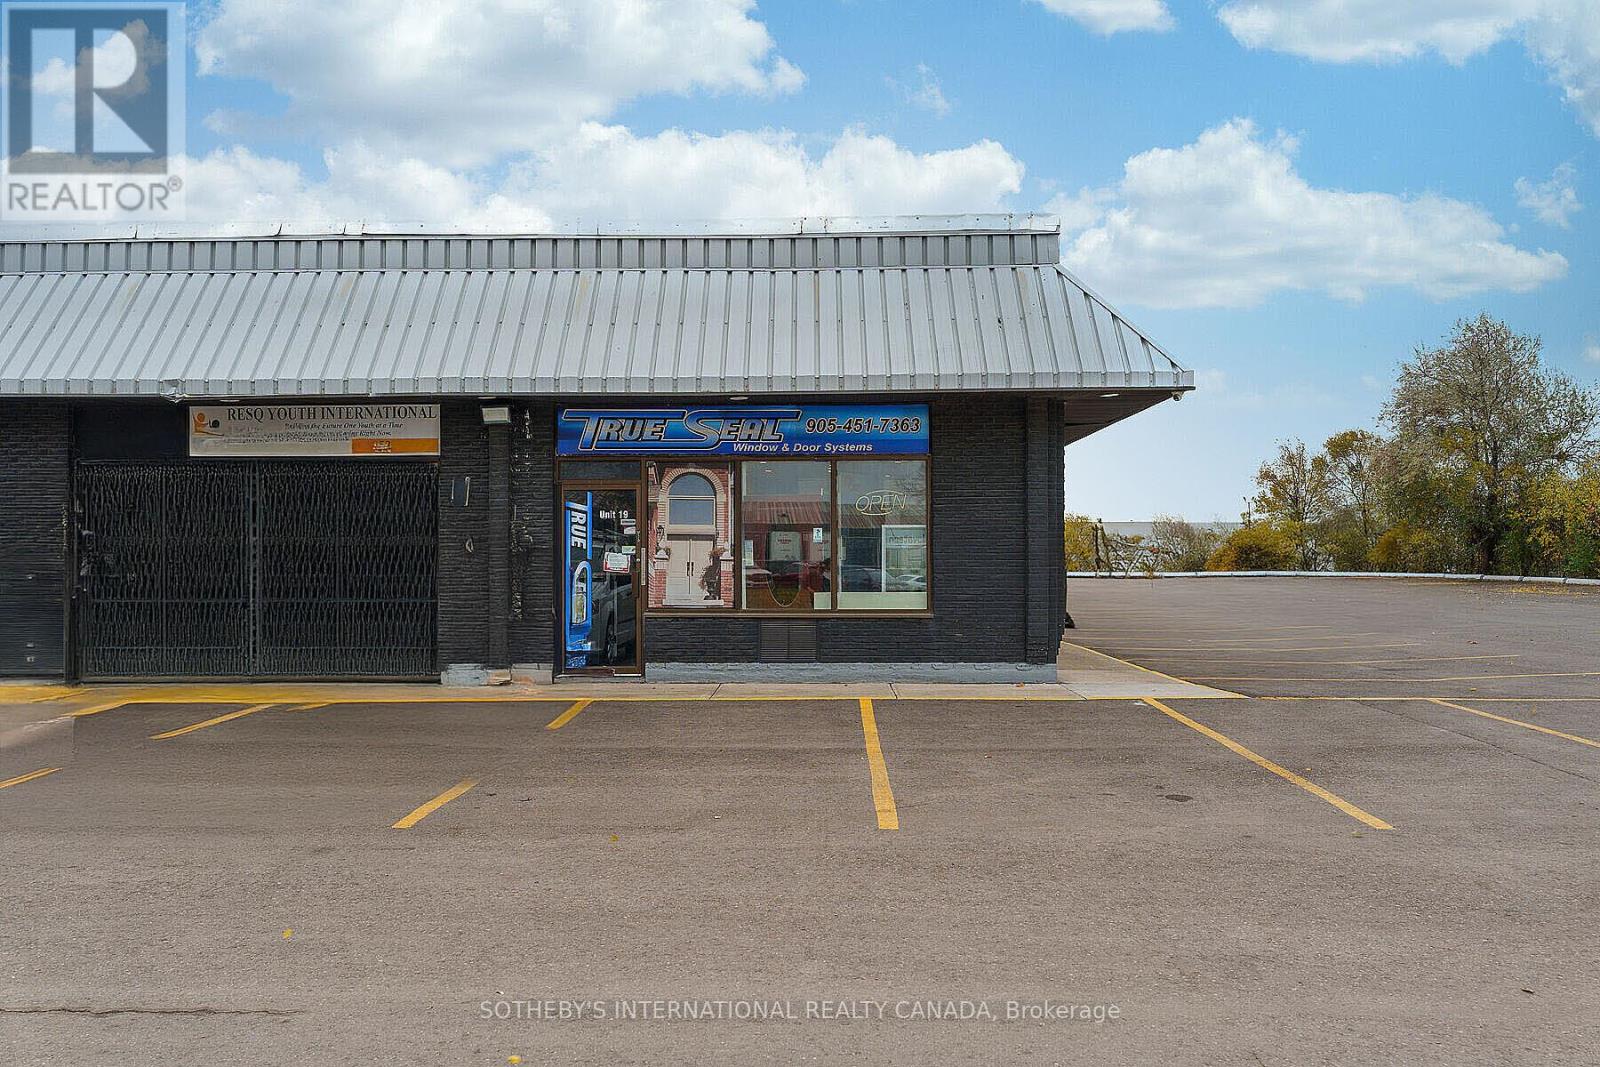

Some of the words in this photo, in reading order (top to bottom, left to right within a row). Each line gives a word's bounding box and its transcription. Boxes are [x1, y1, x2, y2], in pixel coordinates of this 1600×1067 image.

[227, 406, 265, 423] RESQ
[267, 406, 317, 420] YOUTH
[320, 405, 437, 420] INTERNATIONAL
[389, 421, 403, 429] Time
[562, 408, 689, 451] TRUE
[684, 409, 803, 450] SEAL
[805, 416, 921, 434] 905-451-7363
[733, 443, 778, 452] Window
[781, 443, 790, 452] &
[793, 443, 820, 452] Door
[824, 443, 873, 454] Systems
[856, 494, 907, 512] OPEN
[599, 510, 616, 520] Unit
[618, 510, 629, 519] 19
[565, 491, 593, 560] TRUE
